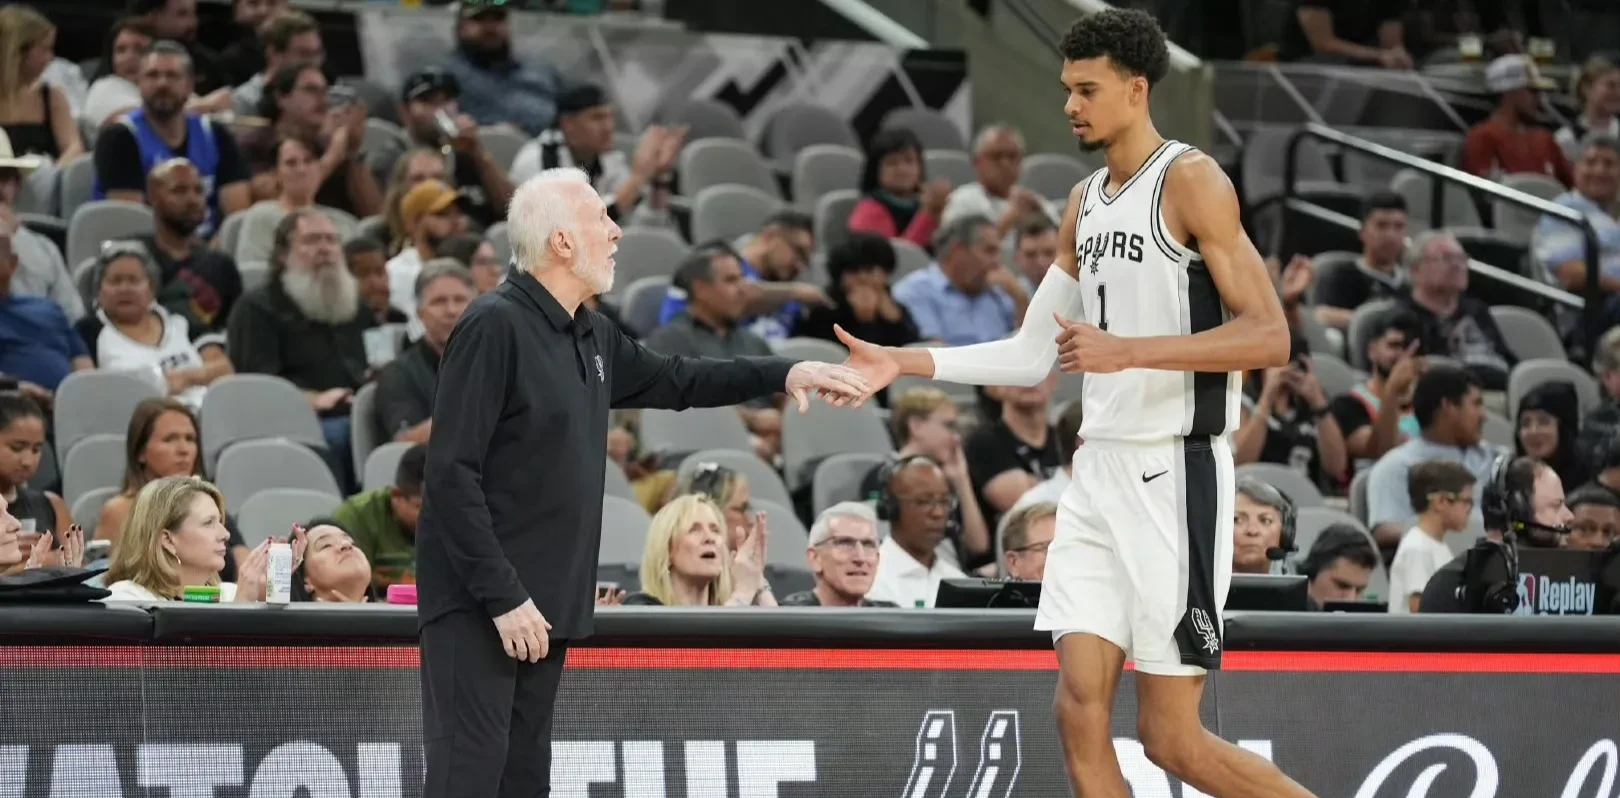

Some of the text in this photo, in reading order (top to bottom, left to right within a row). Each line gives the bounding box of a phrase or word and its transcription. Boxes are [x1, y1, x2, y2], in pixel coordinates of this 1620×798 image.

[1077, 231, 1144, 276] SPURS
[1097, 282, 1109, 331] 1
[1539, 575, 1596, 615] Replay
